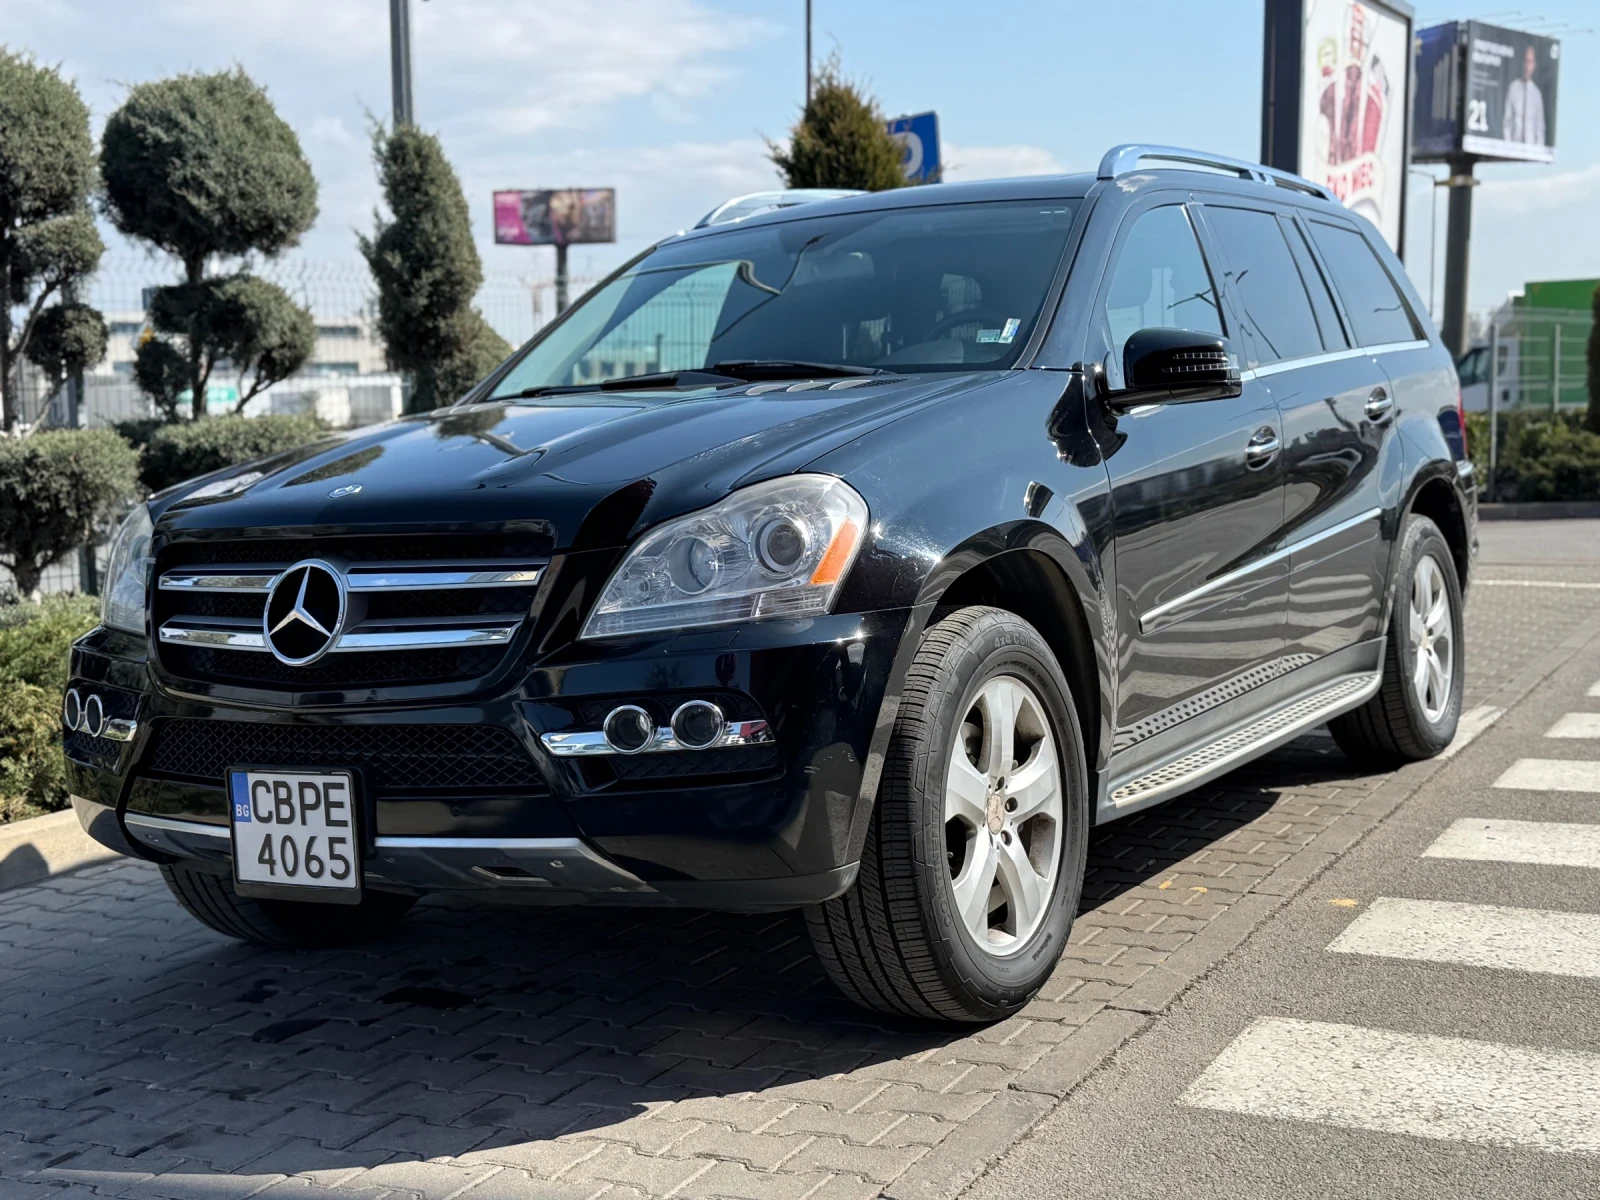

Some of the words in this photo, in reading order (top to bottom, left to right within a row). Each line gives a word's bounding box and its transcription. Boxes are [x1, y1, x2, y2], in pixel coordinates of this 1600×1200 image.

[1468, 99, 1488, 131] 21
[994, 633, 1011, 648] 4x4
[236, 804, 249, 817] BG
[251, 779, 349, 827] CBPE
[258, 833, 350, 880] 4065
